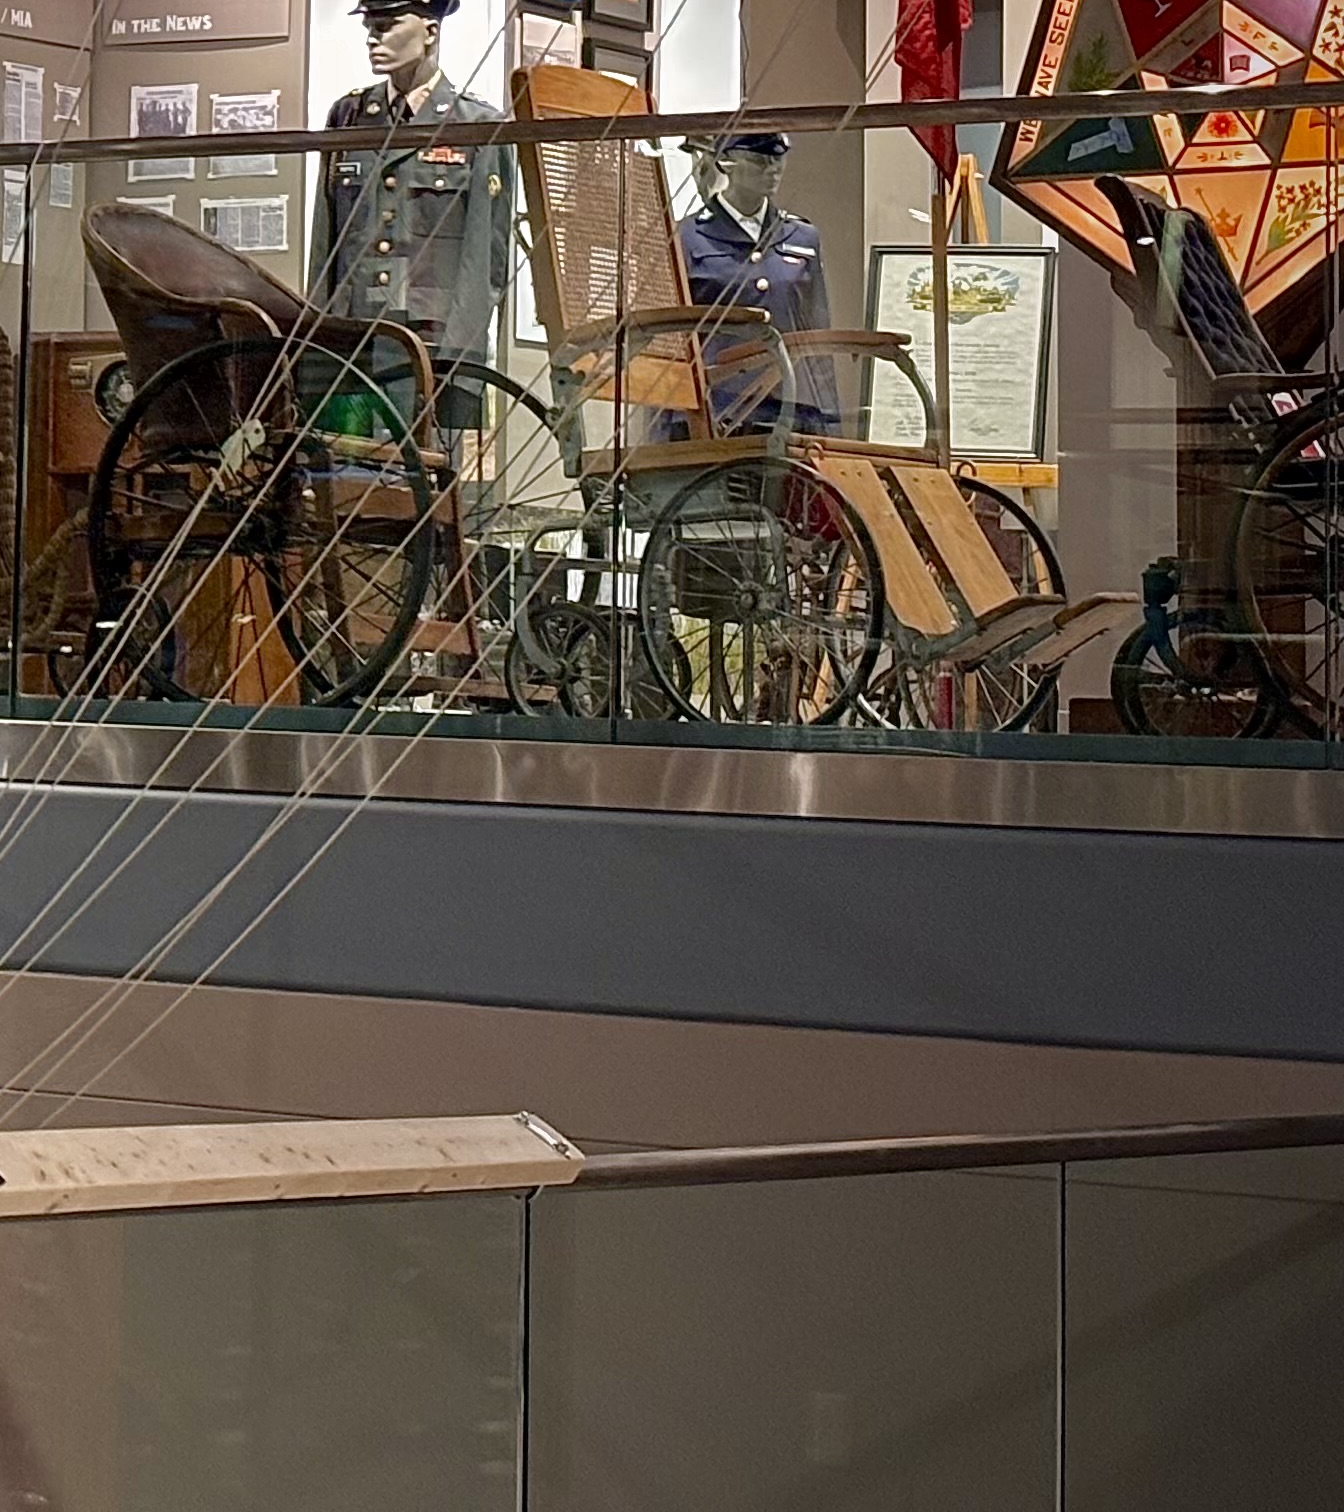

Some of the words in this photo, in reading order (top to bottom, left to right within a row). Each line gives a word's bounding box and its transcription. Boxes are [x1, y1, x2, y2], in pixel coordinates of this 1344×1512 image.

[11, 8, 33, 29] MIA
[111, 18, 126, 34] IN
[131, 18, 161, 33] THE
[165, 14, 213, 33] NEWS
